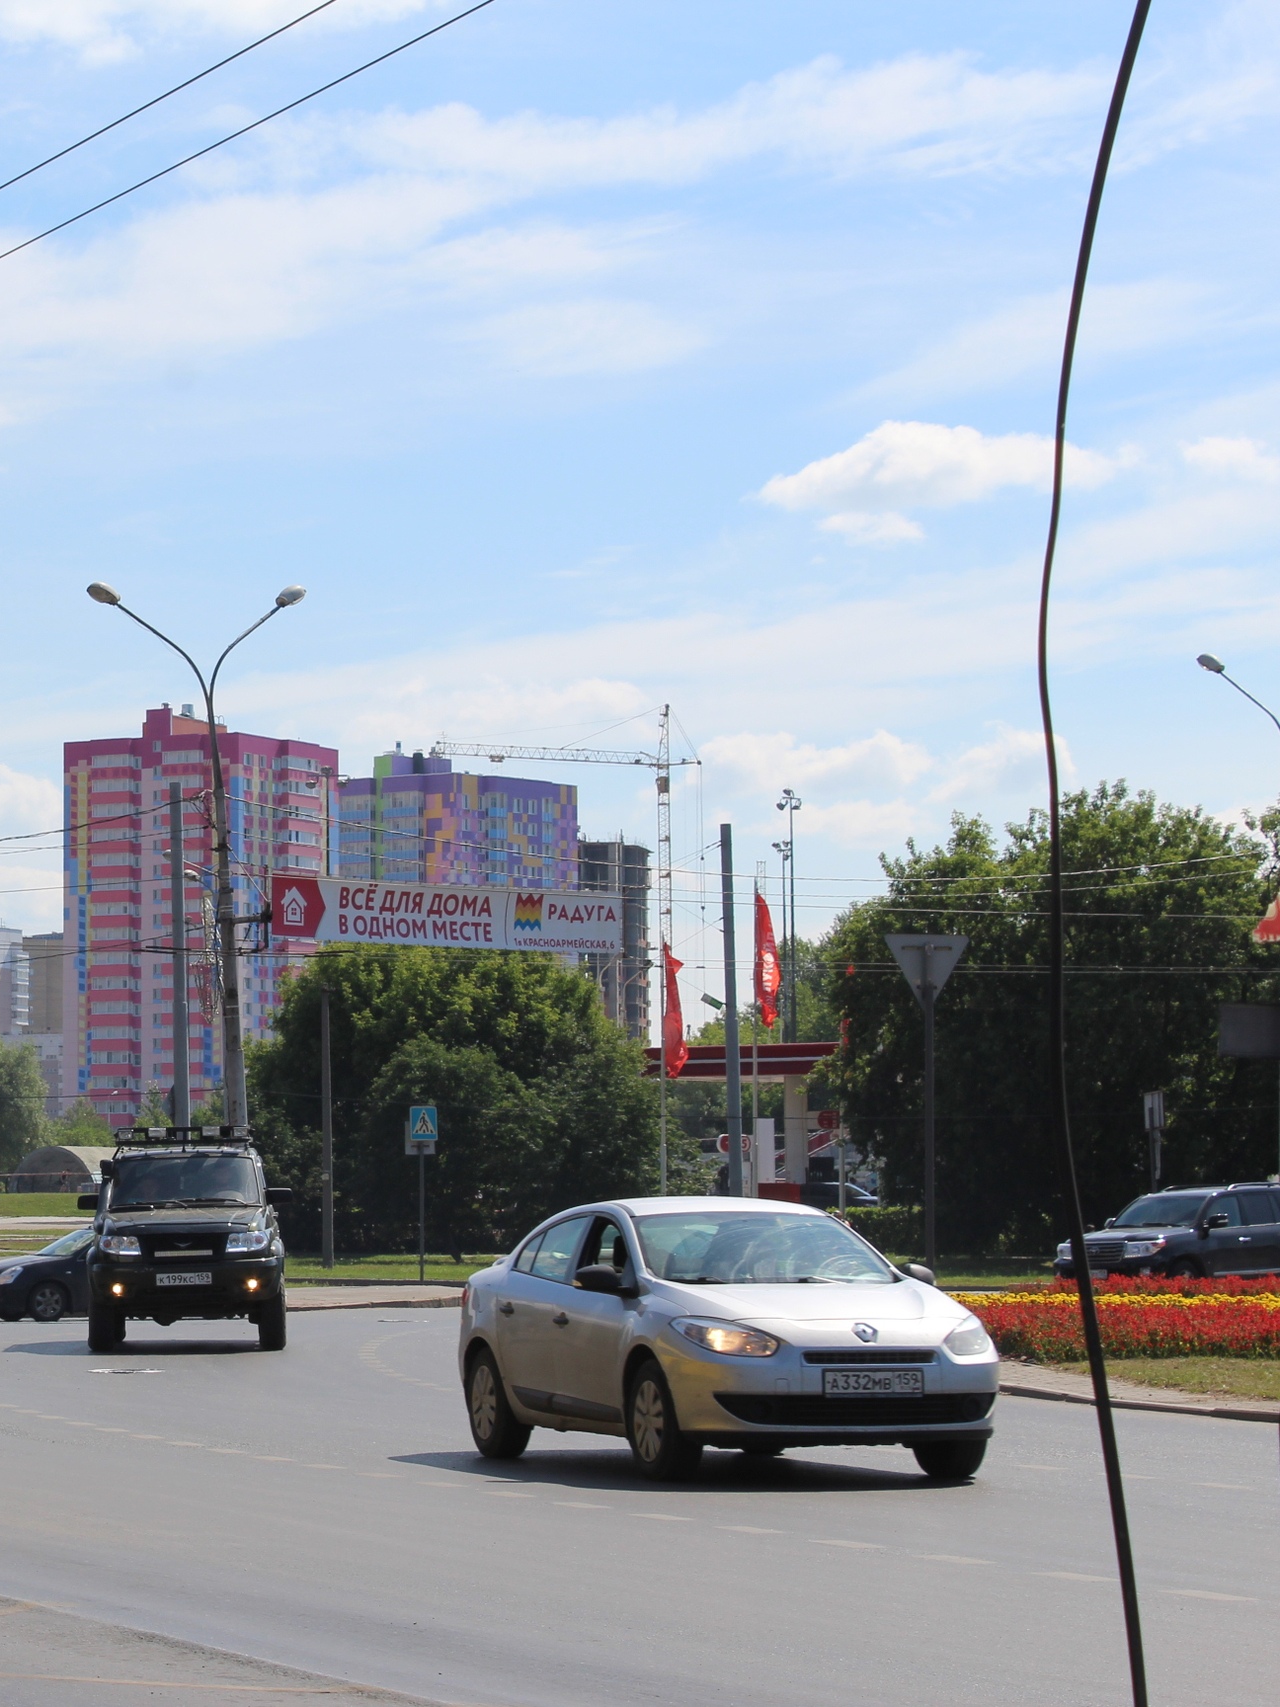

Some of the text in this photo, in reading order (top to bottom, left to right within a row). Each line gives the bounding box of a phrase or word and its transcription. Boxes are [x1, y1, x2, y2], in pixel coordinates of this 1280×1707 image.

[339, 883, 492, 919] ВСЁ ДЛЯ ДОМА
[548, 903, 617, 924] РАДУГА
[338, 914, 493, 942] В ОДНОМ МЕСТЕ
[896, 1373, 918, 1386] 159
